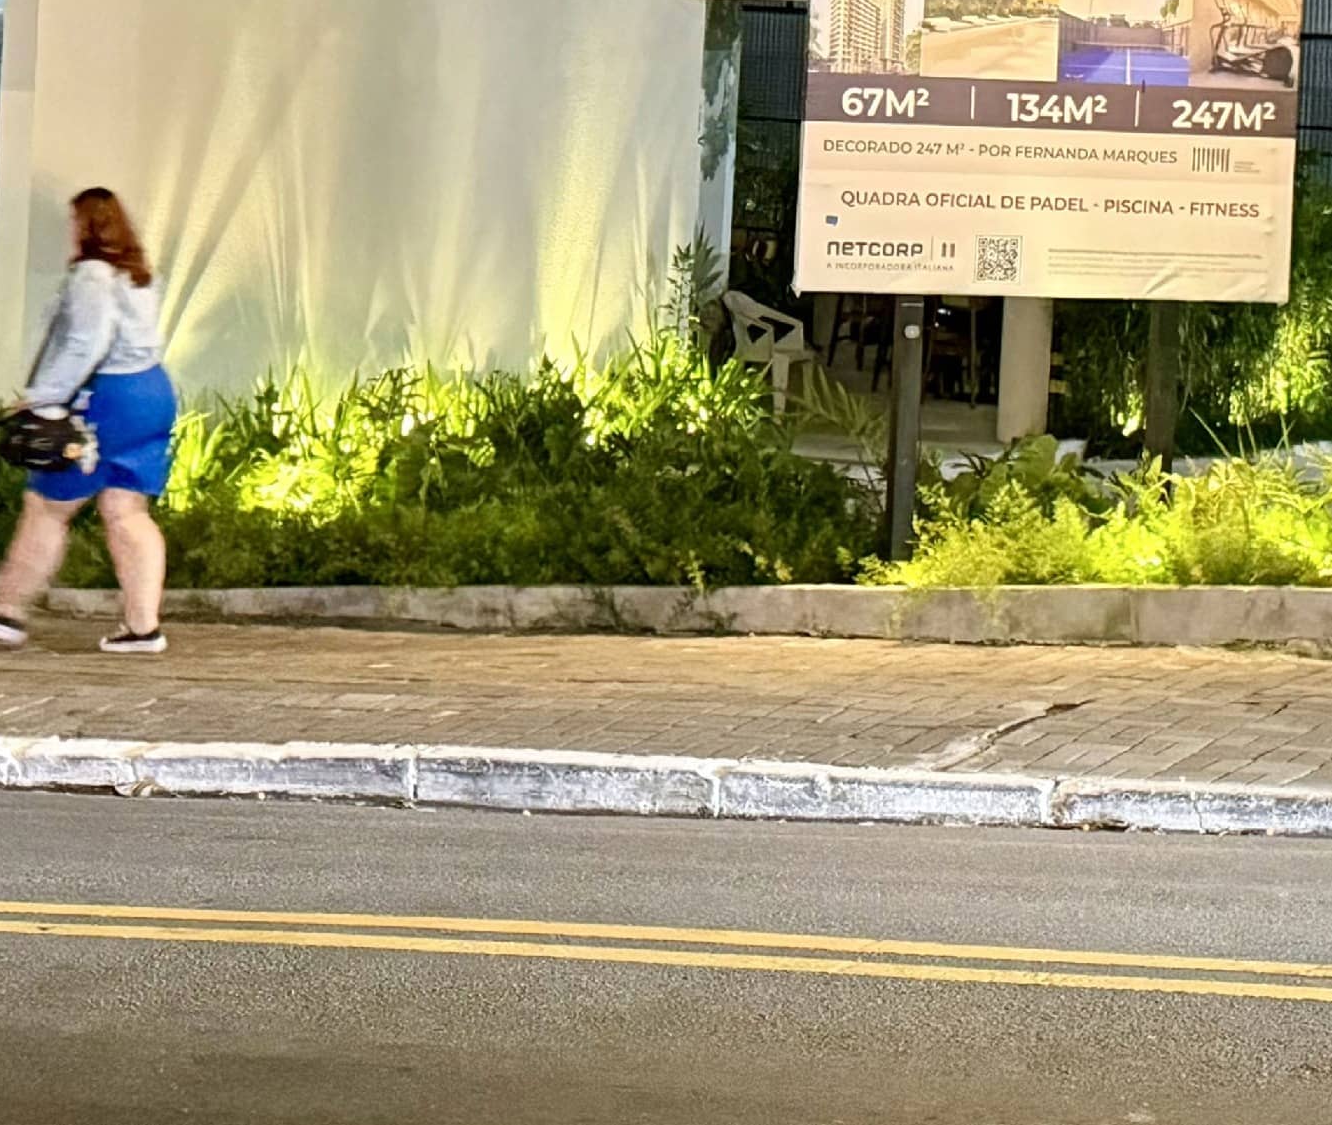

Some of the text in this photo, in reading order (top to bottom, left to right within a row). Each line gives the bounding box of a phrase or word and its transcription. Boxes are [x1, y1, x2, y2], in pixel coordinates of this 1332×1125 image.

[823, 139, 913, 155] DECORADO
[916, 142, 942, 155] 247
[978, 144, 1011, 157] POR
[1015, 145, 1099, 161] FERNANDA
[1102, 148, 1178, 165] MARQUES
[840, 190, 921, 208] QUADRA
[925, 192, 996, 209] OFICIAL
[1000, 195, 1025, 210] DE
[1030, 196, 1089, 213] PADEL
[1103, 198, 1174, 215] PISCINA
[1189, 202, 1260, 218] FITNESS
